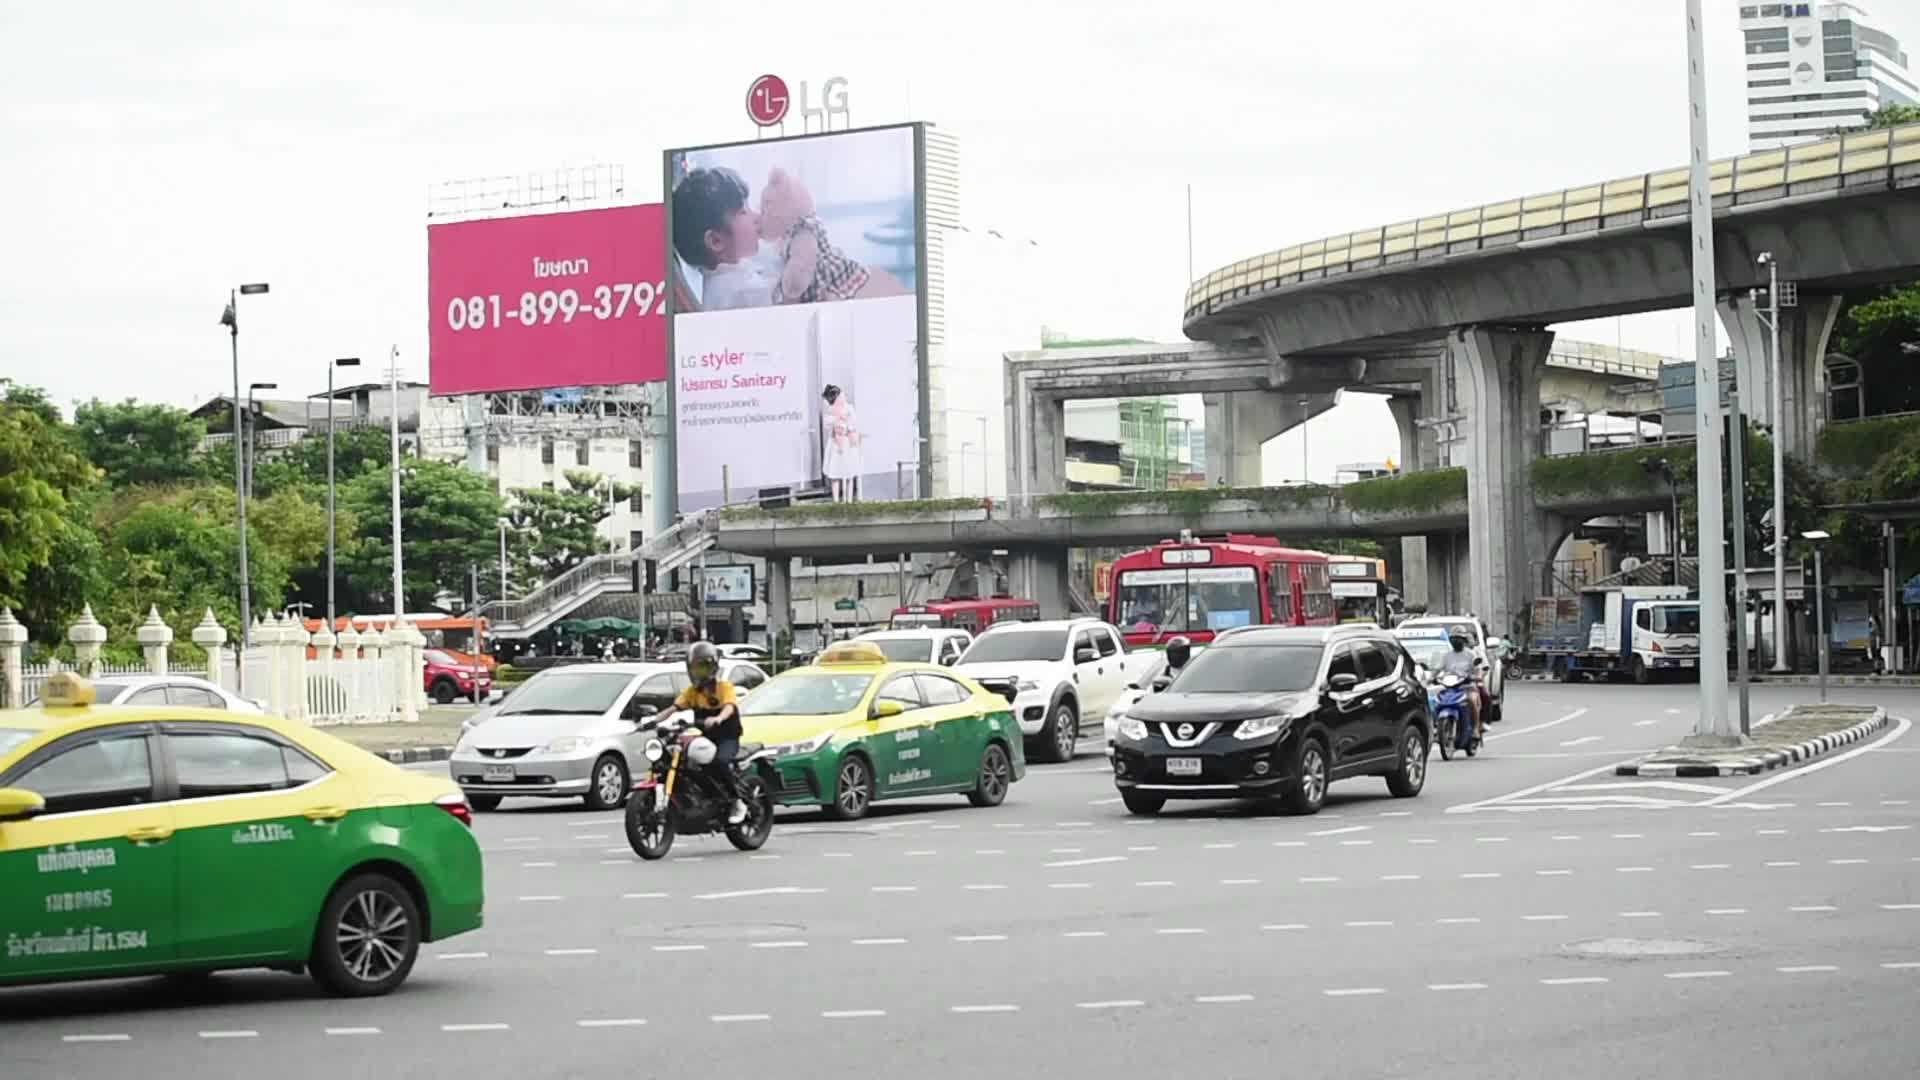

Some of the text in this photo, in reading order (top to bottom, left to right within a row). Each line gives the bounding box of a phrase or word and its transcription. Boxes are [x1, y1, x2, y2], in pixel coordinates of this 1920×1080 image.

[800, 76, 849, 116] LG
[533, 257, 588, 278] โฆษณา
[681, 347, 745, 371] LG styler
[732, 373, 786, 390] Sanitary
